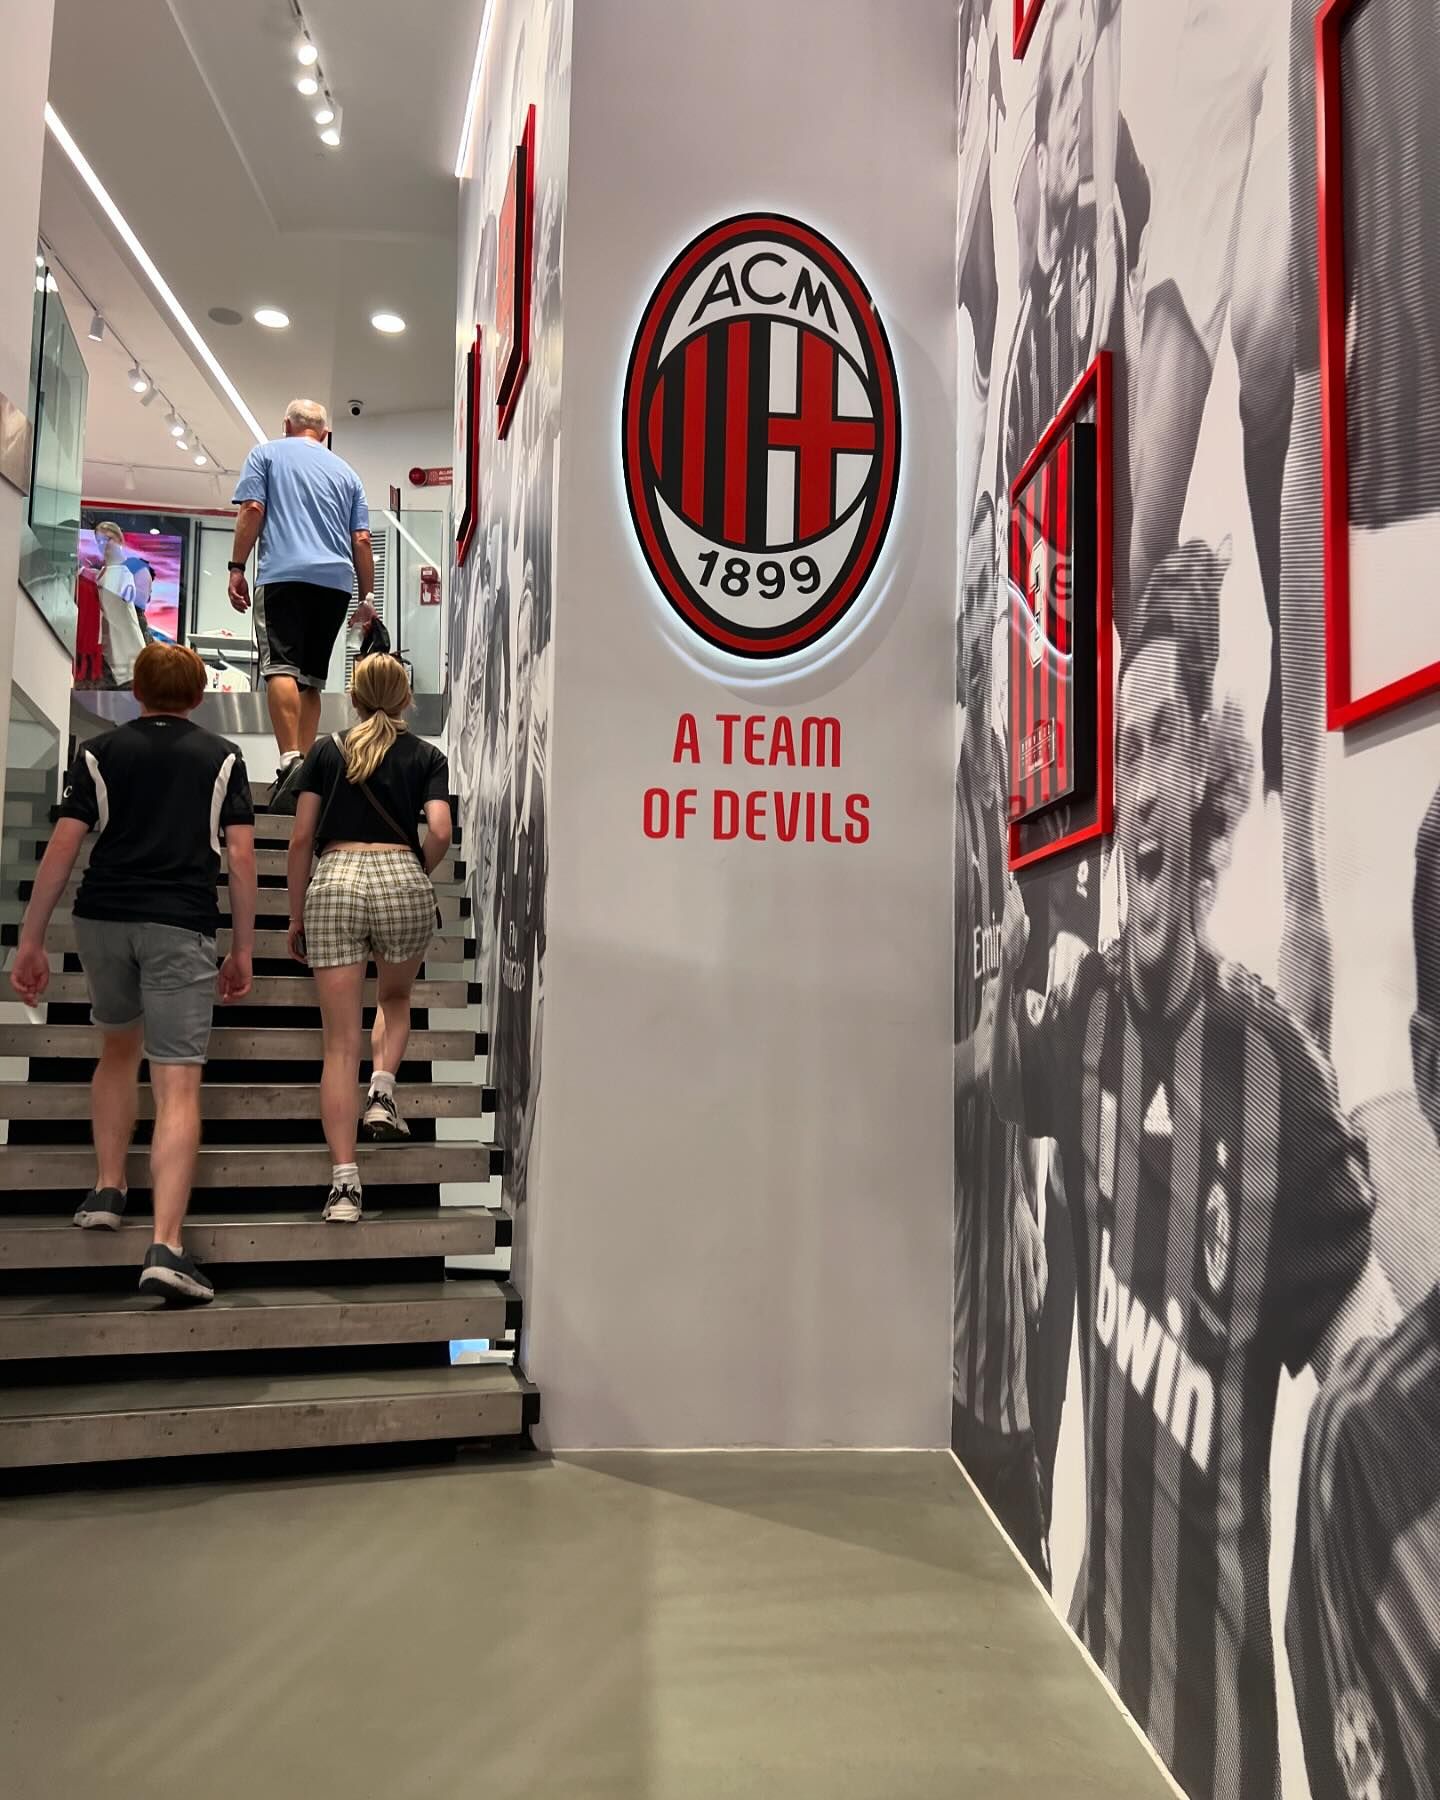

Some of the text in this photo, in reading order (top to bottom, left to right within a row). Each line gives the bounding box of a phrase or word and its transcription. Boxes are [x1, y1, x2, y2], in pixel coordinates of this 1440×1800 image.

[688, 252, 839, 334] ACM
[698, 550, 821, 600] 1899
[673, 713, 841, 768] A TEAM
[643, 787, 870, 844] OF DEVILS
[1096, 1226, 1215, 1474] bwin
